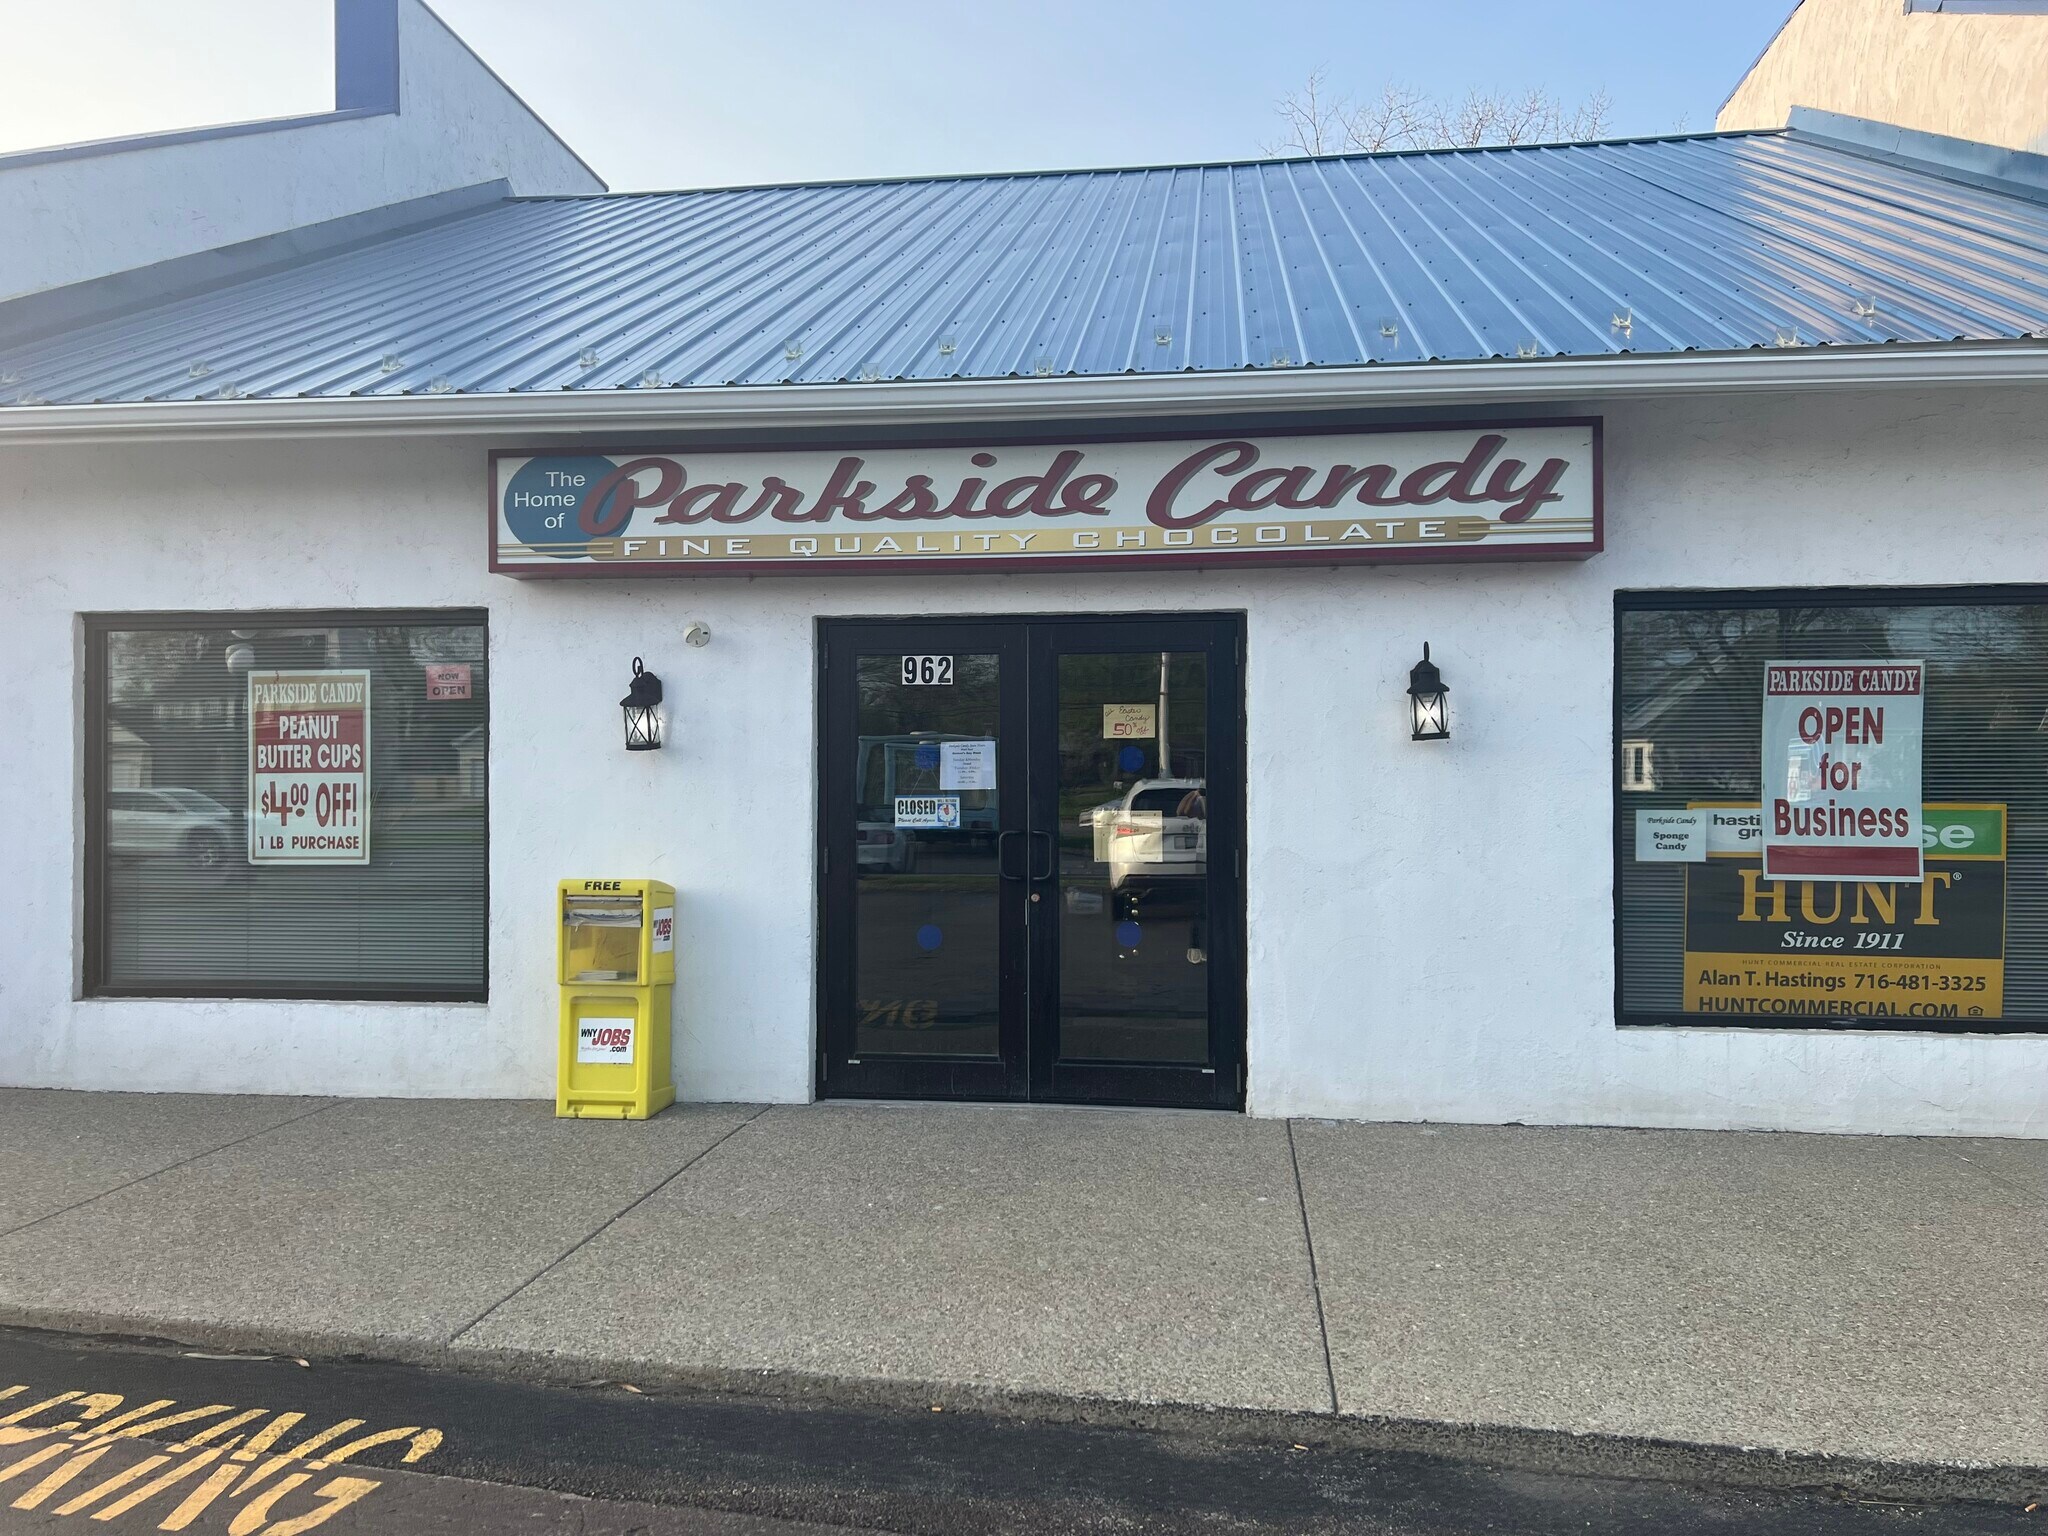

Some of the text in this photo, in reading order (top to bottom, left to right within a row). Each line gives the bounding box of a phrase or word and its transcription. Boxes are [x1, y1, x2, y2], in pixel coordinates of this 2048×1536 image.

[545, 471, 586, 487] The
[577, 434, 1570, 535] Parkside Candy
[514, 491, 576, 507] Home
[544, 512, 565, 529] of
[624, 520, 1447, 557] FINE QUALITY CHOCOLATE
[904, 656, 952, 684] 962
[1769, 669, 1918, 692] PARKSIDE CANDY
[254, 682, 364, 705] PARKSIDE CANDY
[432, 686, 466, 696] OPEN
[279, 715, 340, 739] PEANUT
[1125, 714, 1150, 723] Candy
[1798, 706, 1885, 745] OPEN
[257, 743, 361, 768] BUTTER CUPS
[1818, 752, 1862, 791] for
[315, 782, 357, 827] OFF!
[897, 799, 936, 815] CLOSED
[1647, 816, 1697, 825] Parkside Candy
[1713, 814, 1762, 826] hasti
[1774, 799, 1910, 838] Business
[259, 836, 360, 849] 1 LB PURCHASE
[1653, 831, 1689, 841] Sponge
[1655, 842, 1687, 851] Candy
[584, 881, 621, 891] FREE
[1780, 931, 1905, 950] Since 1911
[1768, 959, 1823, 967] COMMERCIAL
[1881, 962, 1942, 970] CORPORATION
[1699, 970, 1987, 992] Alan T. Hastings 716-481-3325
[1699, 996, 1958, 1018] HUNTCOMMERCIAL.COM
